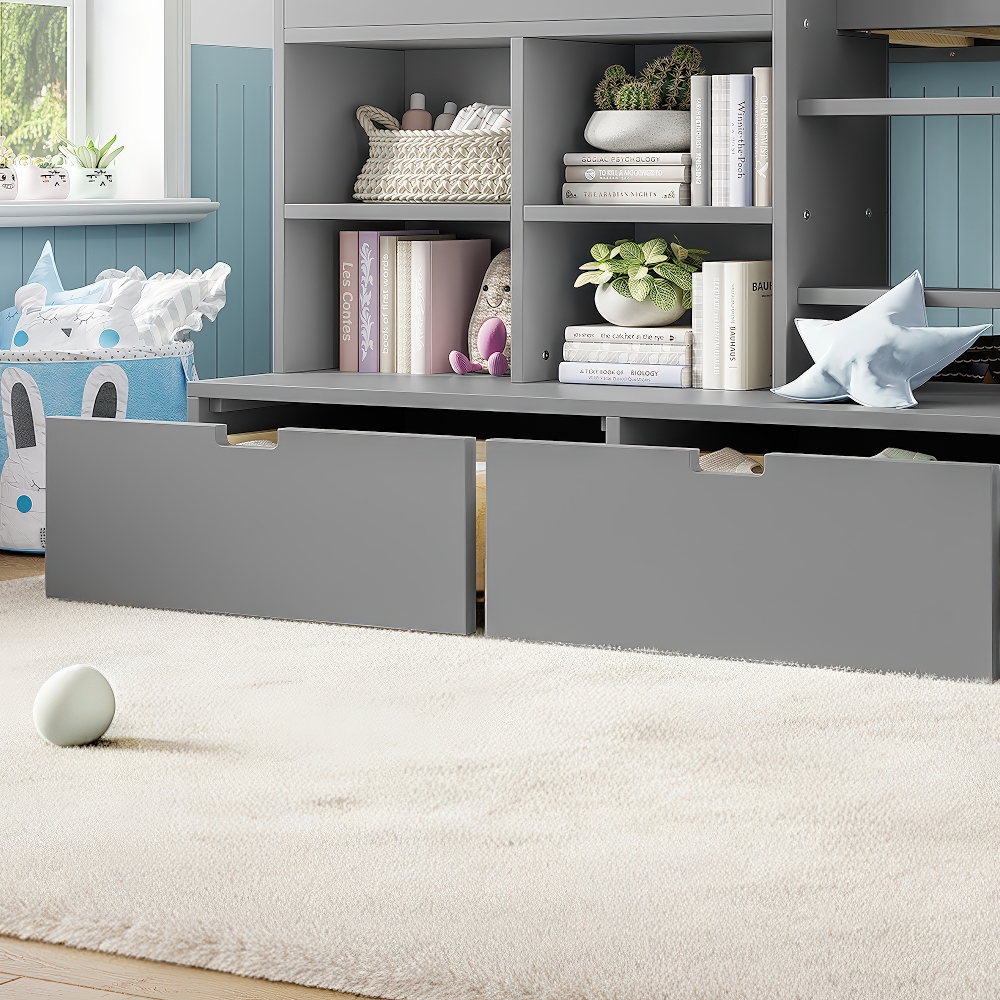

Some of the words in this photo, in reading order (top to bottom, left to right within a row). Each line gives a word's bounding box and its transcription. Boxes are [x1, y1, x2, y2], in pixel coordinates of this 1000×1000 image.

[760, 95, 769, 129] OLIVER
[760, 132, 769, 159] TWIST
[342, 261, 354, 287] Les
[342, 291, 354, 342] Contes
[382, 313, 389, 325] of
[630, 369, 660, 377] BIOLOGY
